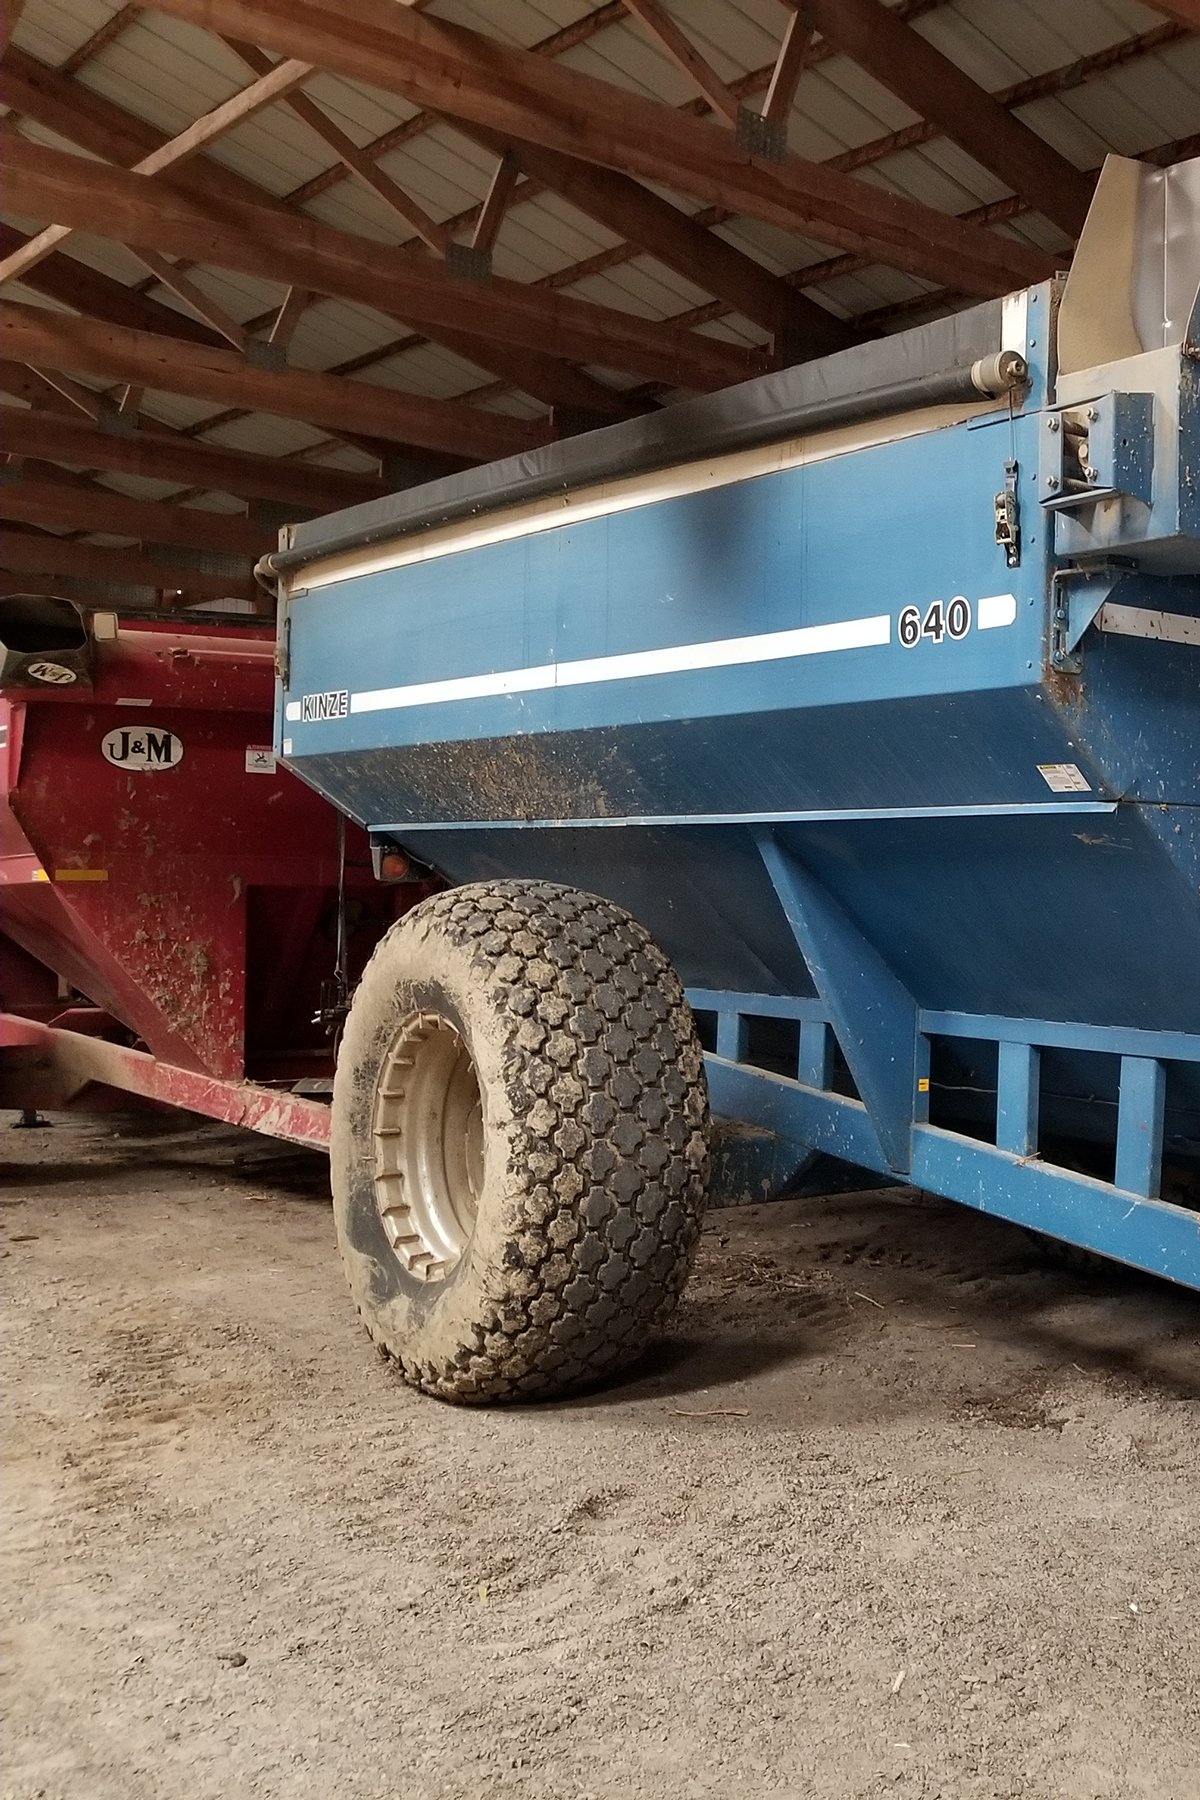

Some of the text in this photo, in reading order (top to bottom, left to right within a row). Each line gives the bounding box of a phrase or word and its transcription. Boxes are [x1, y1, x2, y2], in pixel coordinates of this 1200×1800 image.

[899, 597, 970, 646] 640
[302, 691, 348, 722] KINZE
[107, 732, 173, 763] J&M
